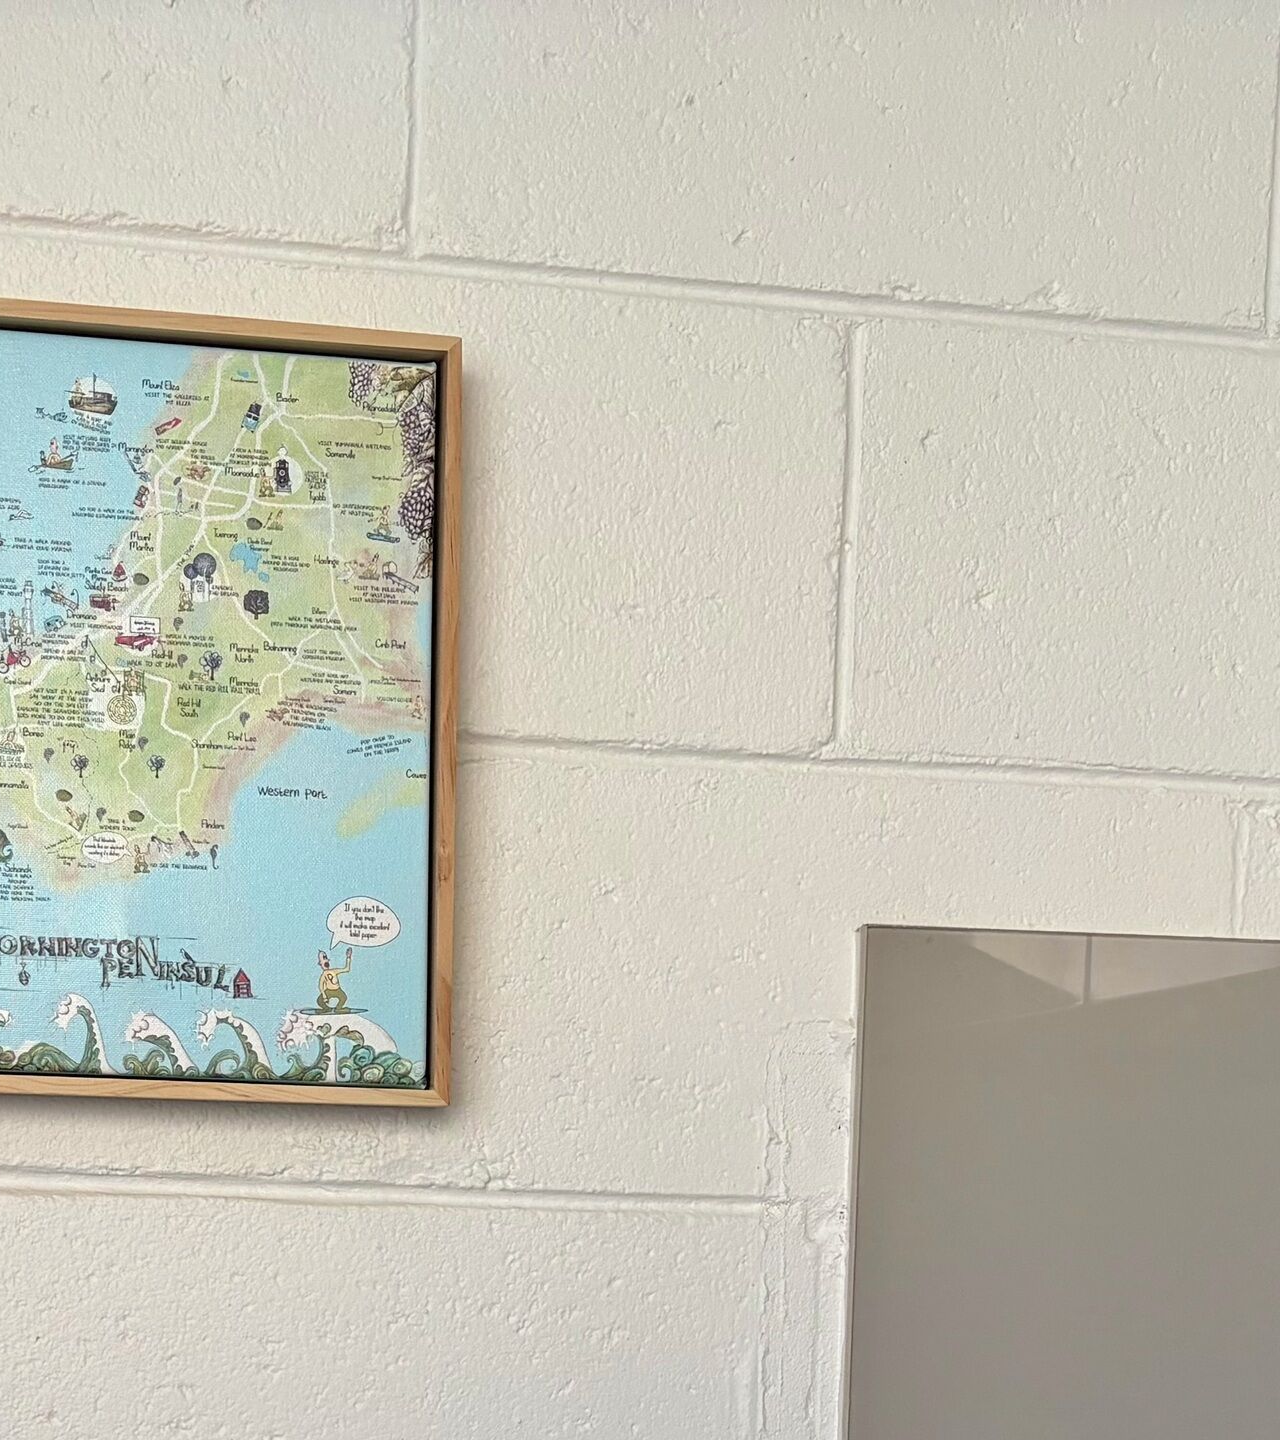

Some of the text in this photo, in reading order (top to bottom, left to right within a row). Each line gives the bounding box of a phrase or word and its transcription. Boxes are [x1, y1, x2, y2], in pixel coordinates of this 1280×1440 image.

[142, 379, 180, 391] Mount Eliza
[118, 442, 154, 457] Mornington
[130, 530, 151, 541] Mount
[129, 541, 154, 552] Martha
[107, 582, 129, 592] Beach
[66, 608, 97, 620] Dromana
[375, 638, 406, 650] Crib Point
[235, 653, 254, 664] North
[333, 685, 357, 696] Somers
[177, 697, 202, 708] Red Hill
[180, 708, 199, 718] South
[22, 726, 45, 737] Boneo
[119, 729, 135, 739] Main
[227, 731, 257, 742] Point Leo
[191, 739, 223, 750] Shoreham
[406, 768, 427, 780] Cowes
[257, 785, 300, 797] Western
[344, 903, 350, 912] If
[364, 916, 376, 924] map
